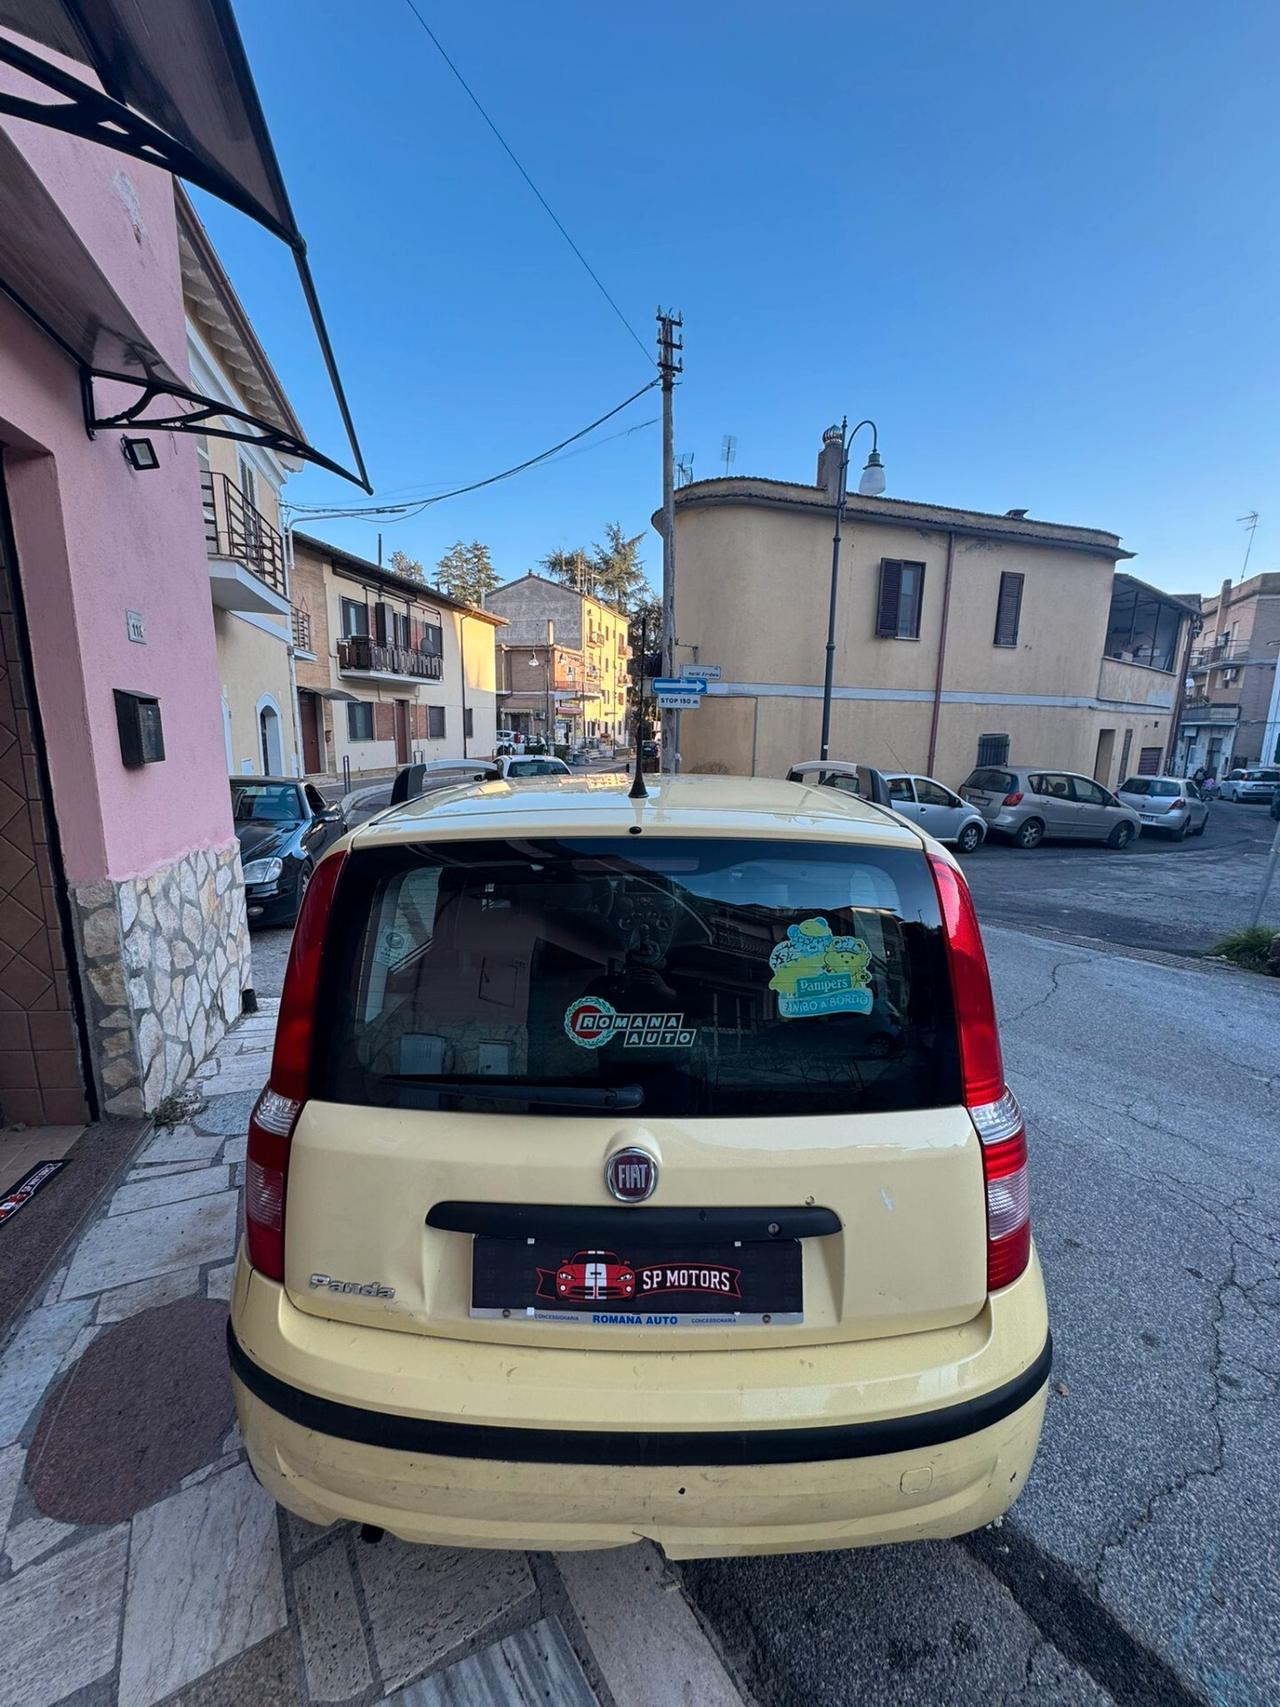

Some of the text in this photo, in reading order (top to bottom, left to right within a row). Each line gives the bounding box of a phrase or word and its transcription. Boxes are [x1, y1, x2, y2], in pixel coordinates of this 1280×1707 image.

[800, 977, 848, 993] Pampers
[582, 1014, 680, 1029] ROMANA
[628, 1031, 691, 1045] AUTO
[618, 1164, 648, 1188] FIAT
[309, 1273, 396, 1299] Panda
[642, 1269, 730, 1291] SP MOTORS
[592, 1314, 678, 1325] ROMANA AUTO
